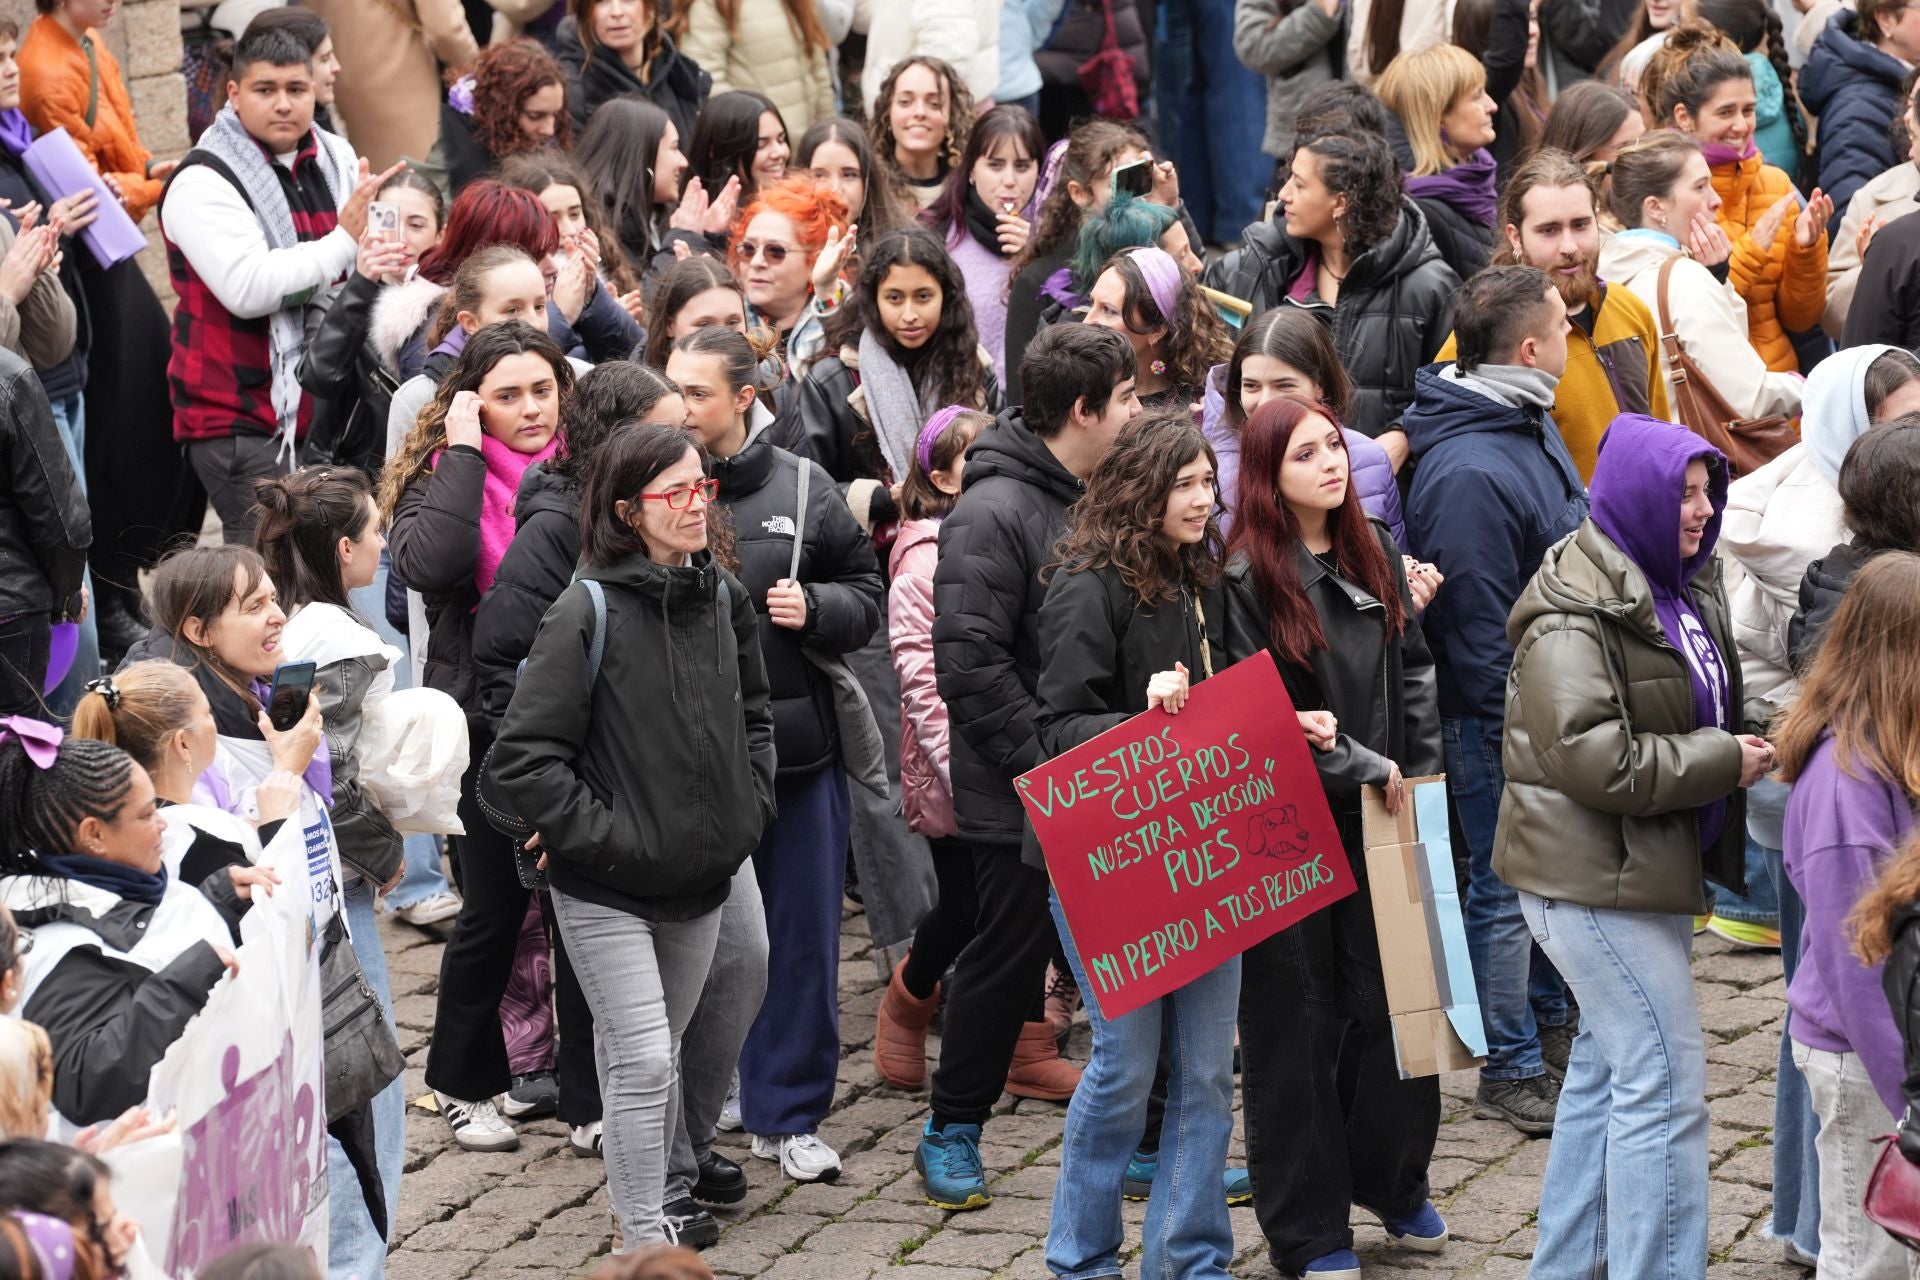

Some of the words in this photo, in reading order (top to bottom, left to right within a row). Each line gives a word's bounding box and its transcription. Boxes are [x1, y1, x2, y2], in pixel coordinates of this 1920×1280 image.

[761, 520, 785, 528] NORTH
[1111, 733, 1250, 820] CUERPOS
[1087, 814, 1187, 881] NUESTRA
[1163, 828, 1241, 893] PUES
[1091, 953, 1125, 993] MI
[1122, 919, 1200, 981] PERRO
[1204, 909, 1225, 939] A
[1218, 885, 1265, 928] TUS
[1261, 853, 1335, 911] PELOTAS
